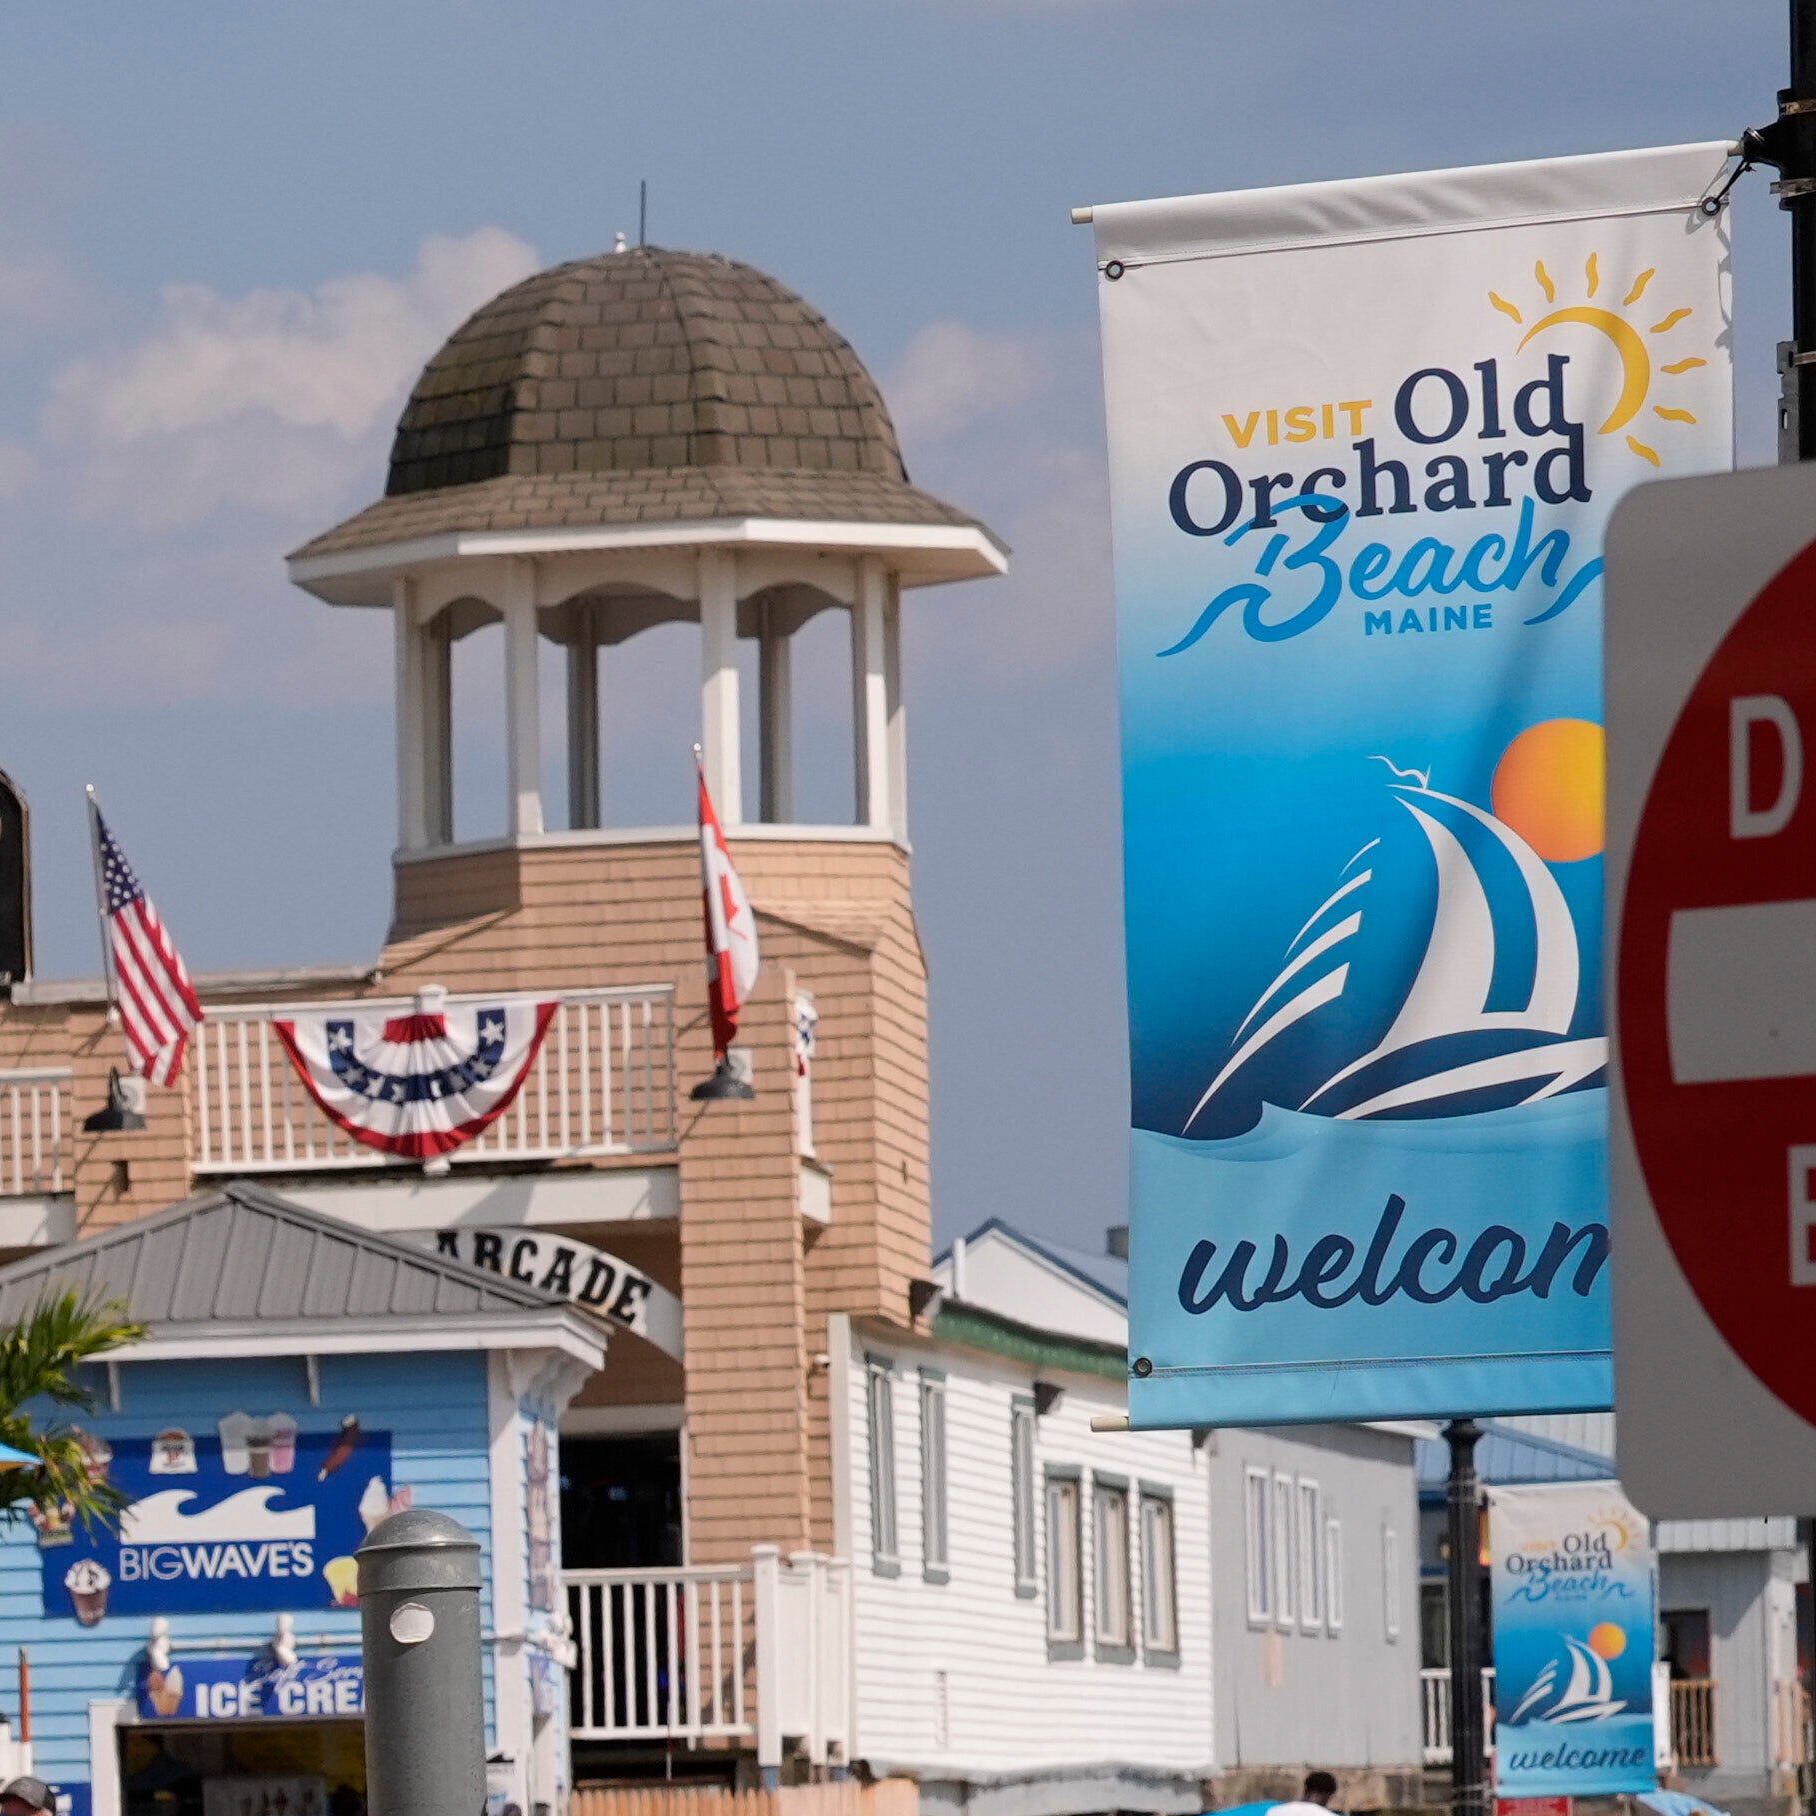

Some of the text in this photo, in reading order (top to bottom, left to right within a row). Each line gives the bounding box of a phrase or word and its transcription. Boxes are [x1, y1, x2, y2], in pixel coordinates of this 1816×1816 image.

[1220, 353, 1585, 449] VISIT Old
[1167, 422, 1593, 537] Orchard
[1217, 494, 1575, 646] Beach
[1363, 603, 1494, 635] MAINE
[1177, 1192, 1611, 1316] welcom
[435, 1230, 653, 1326] ARCADE
[1505, 1549, 1613, 1575] Orchard
[1562, 1531, 1608, 1554] Old
[1527, 1566, 1610, 1602] Beach
[194, 1678, 366, 1718] ICE CRE
[1509, 1742, 1647, 1769] welcome
